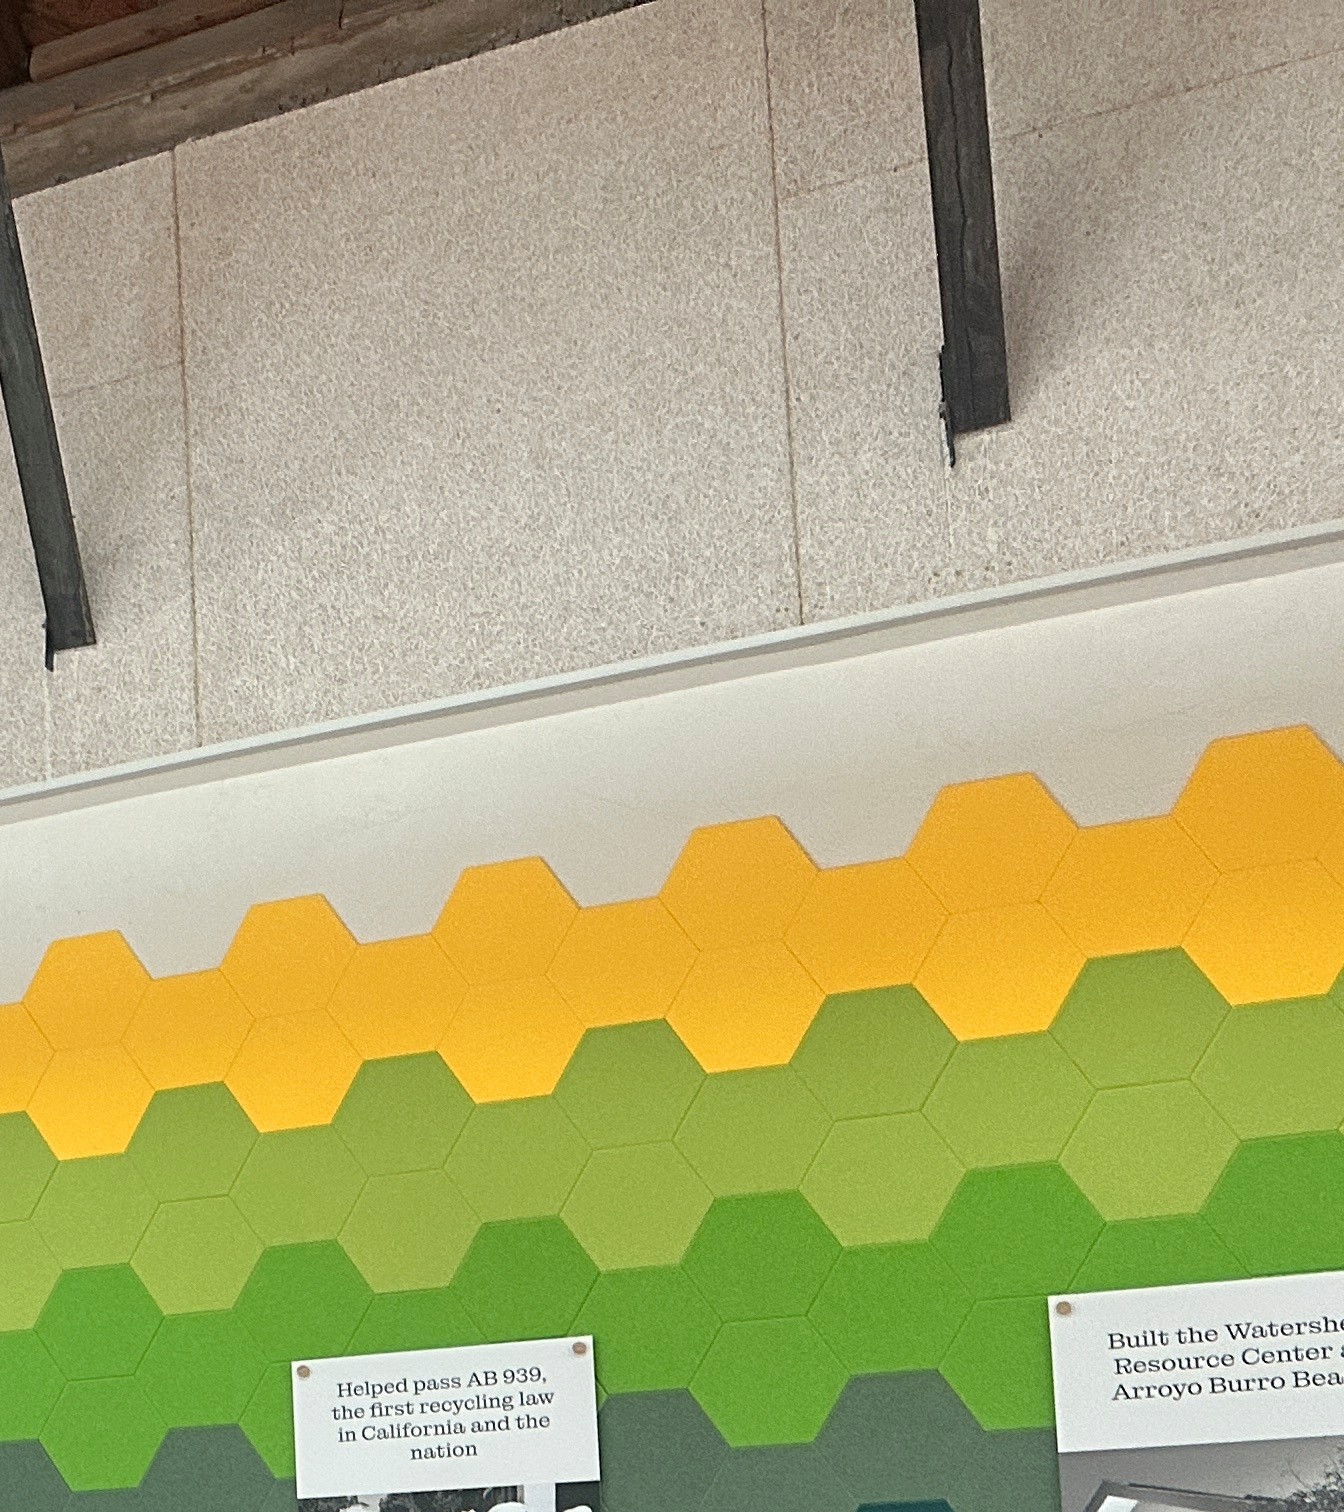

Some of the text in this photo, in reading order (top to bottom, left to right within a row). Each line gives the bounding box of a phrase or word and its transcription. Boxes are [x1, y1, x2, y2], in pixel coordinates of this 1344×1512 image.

[1108, 1316, 1344, 1350] Built the Watersh
[1113, 1353, 1235, 1375] Resource
[1241, 1345, 1334, 1366] Center
[337, 1366, 547, 1399] Helped pass AB 939,
[1112, 1381, 1203, 1401] Arroyo
[1208, 1376, 1286, 1395] Burro
[331, 1391, 555, 1421] the first recycling law
[337, 1414, 551, 1443] in California and the
[410, 1442, 478, 1461] nation
